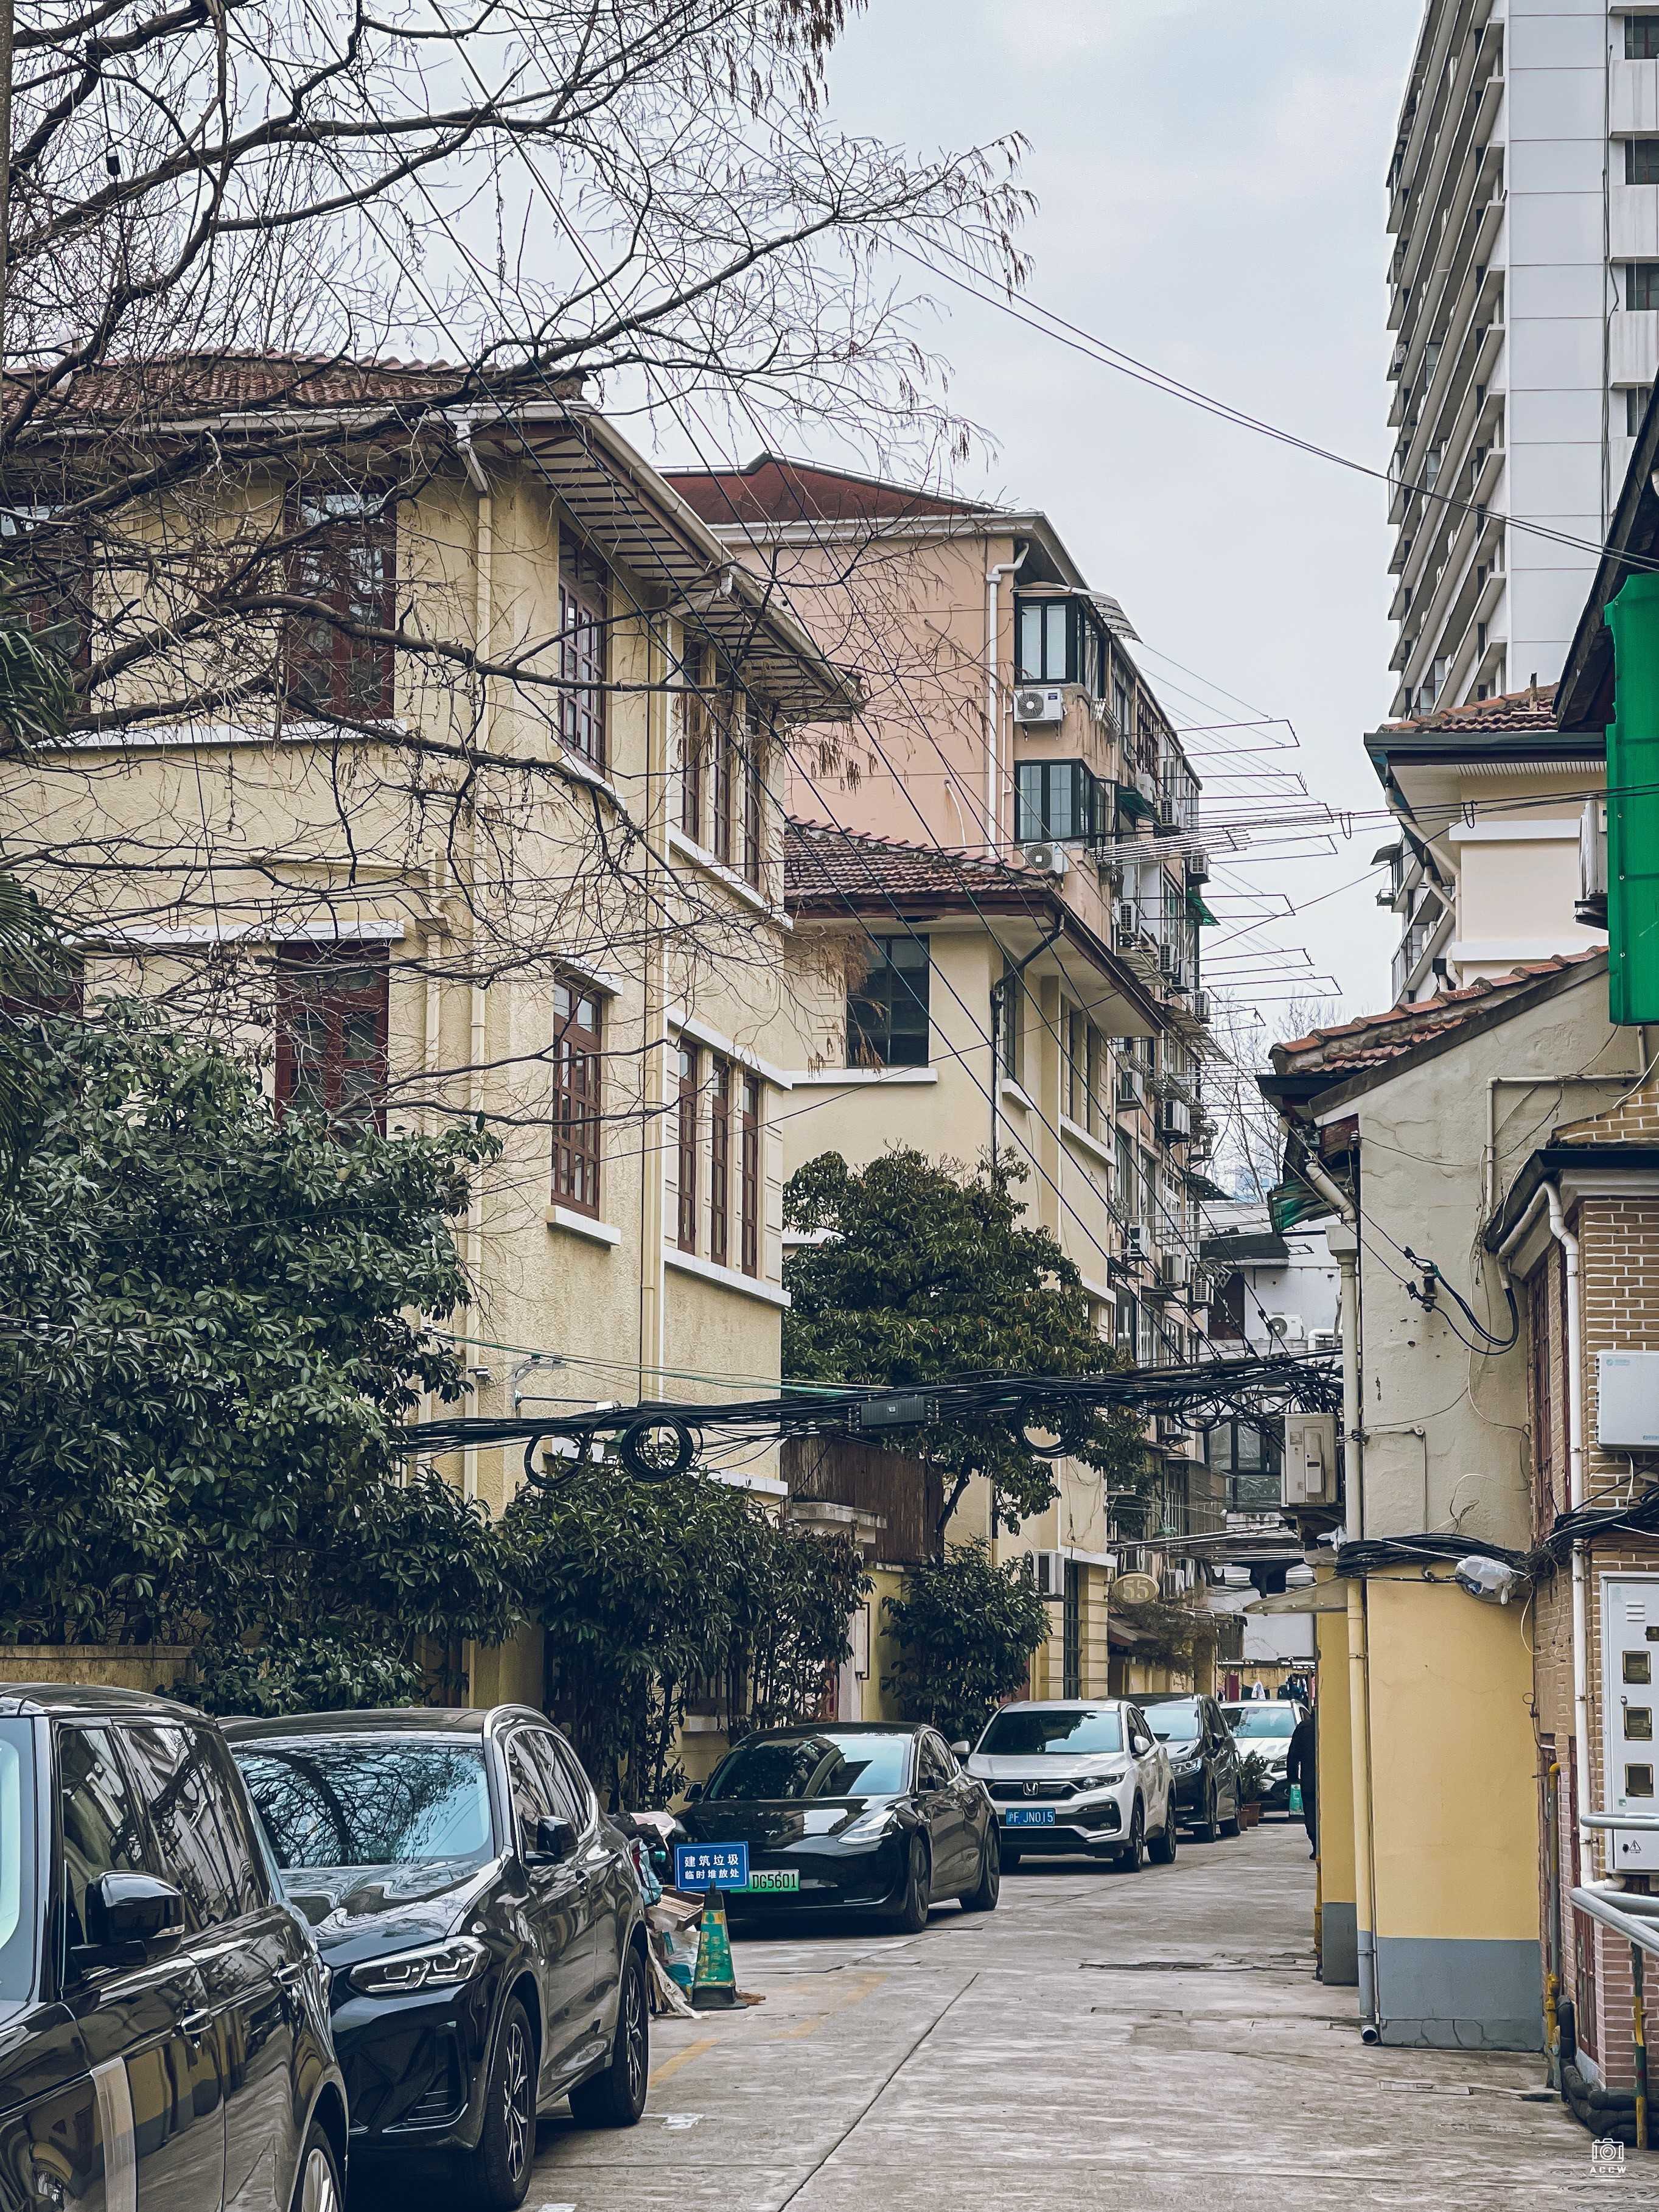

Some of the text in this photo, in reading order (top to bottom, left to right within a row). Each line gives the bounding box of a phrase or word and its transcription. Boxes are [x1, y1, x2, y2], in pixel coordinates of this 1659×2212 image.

[1123, 1580, 1150, 1600] 55
[684, 1853, 739, 1867] 建筑垃圾
[685, 1868, 740, 1880] 临时堆放处
[752, 1874, 796, 1889] DG5601
